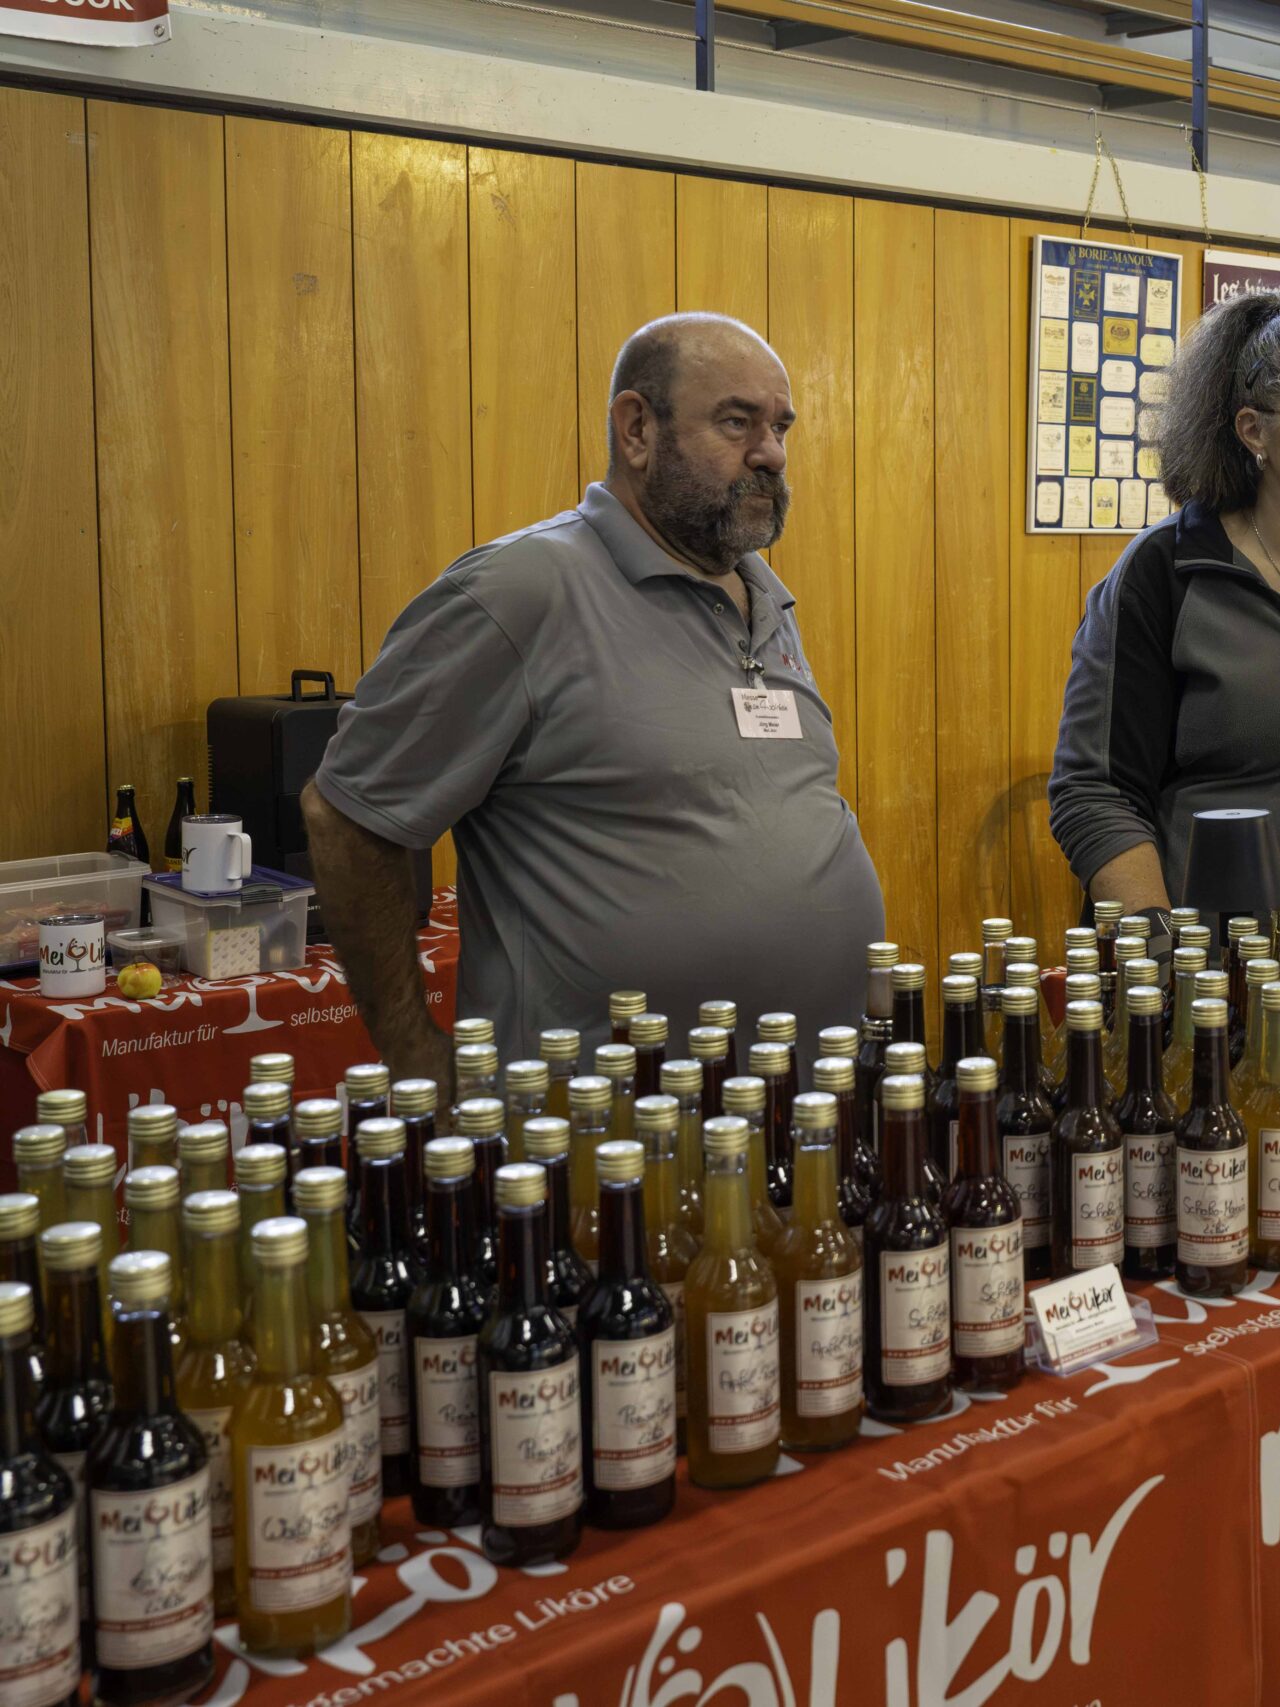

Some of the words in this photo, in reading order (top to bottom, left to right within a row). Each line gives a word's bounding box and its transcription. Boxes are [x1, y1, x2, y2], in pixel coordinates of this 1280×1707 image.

[1078, 246, 1155, 268] BORIE-MANOUX
[1213, 272, 1240, 306] les
[39, 942, 64, 966] Mei
[101, 1027, 195, 1057] Manufaktur
[196, 1022, 219, 1043] für
[1010, 1143, 1037, 1163] Mei
[1129, 1143, 1155, 1163] Mei
[1078, 1161, 1105, 1182] Mei
[1180, 1160, 1203, 1180] Mei
[956, 1237, 987, 1260] Mei
[888, 1261, 919, 1284] Mei
[804, 1287, 836, 1313] Mei
[1045, 1296, 1072, 1323] Mei
[1083, 1281, 1117, 1313] Likör
[715, 1321, 749, 1346] Mei
[422, 1349, 459, 1374] Mei
[600, 1351, 637, 1377] Mei
[499, 1383, 536, 1410] Mei
[254, 1457, 295, 1485] Mei
[100, 1505, 142, 1534] Mei
[514, 1574, 636, 1632] Liköre
